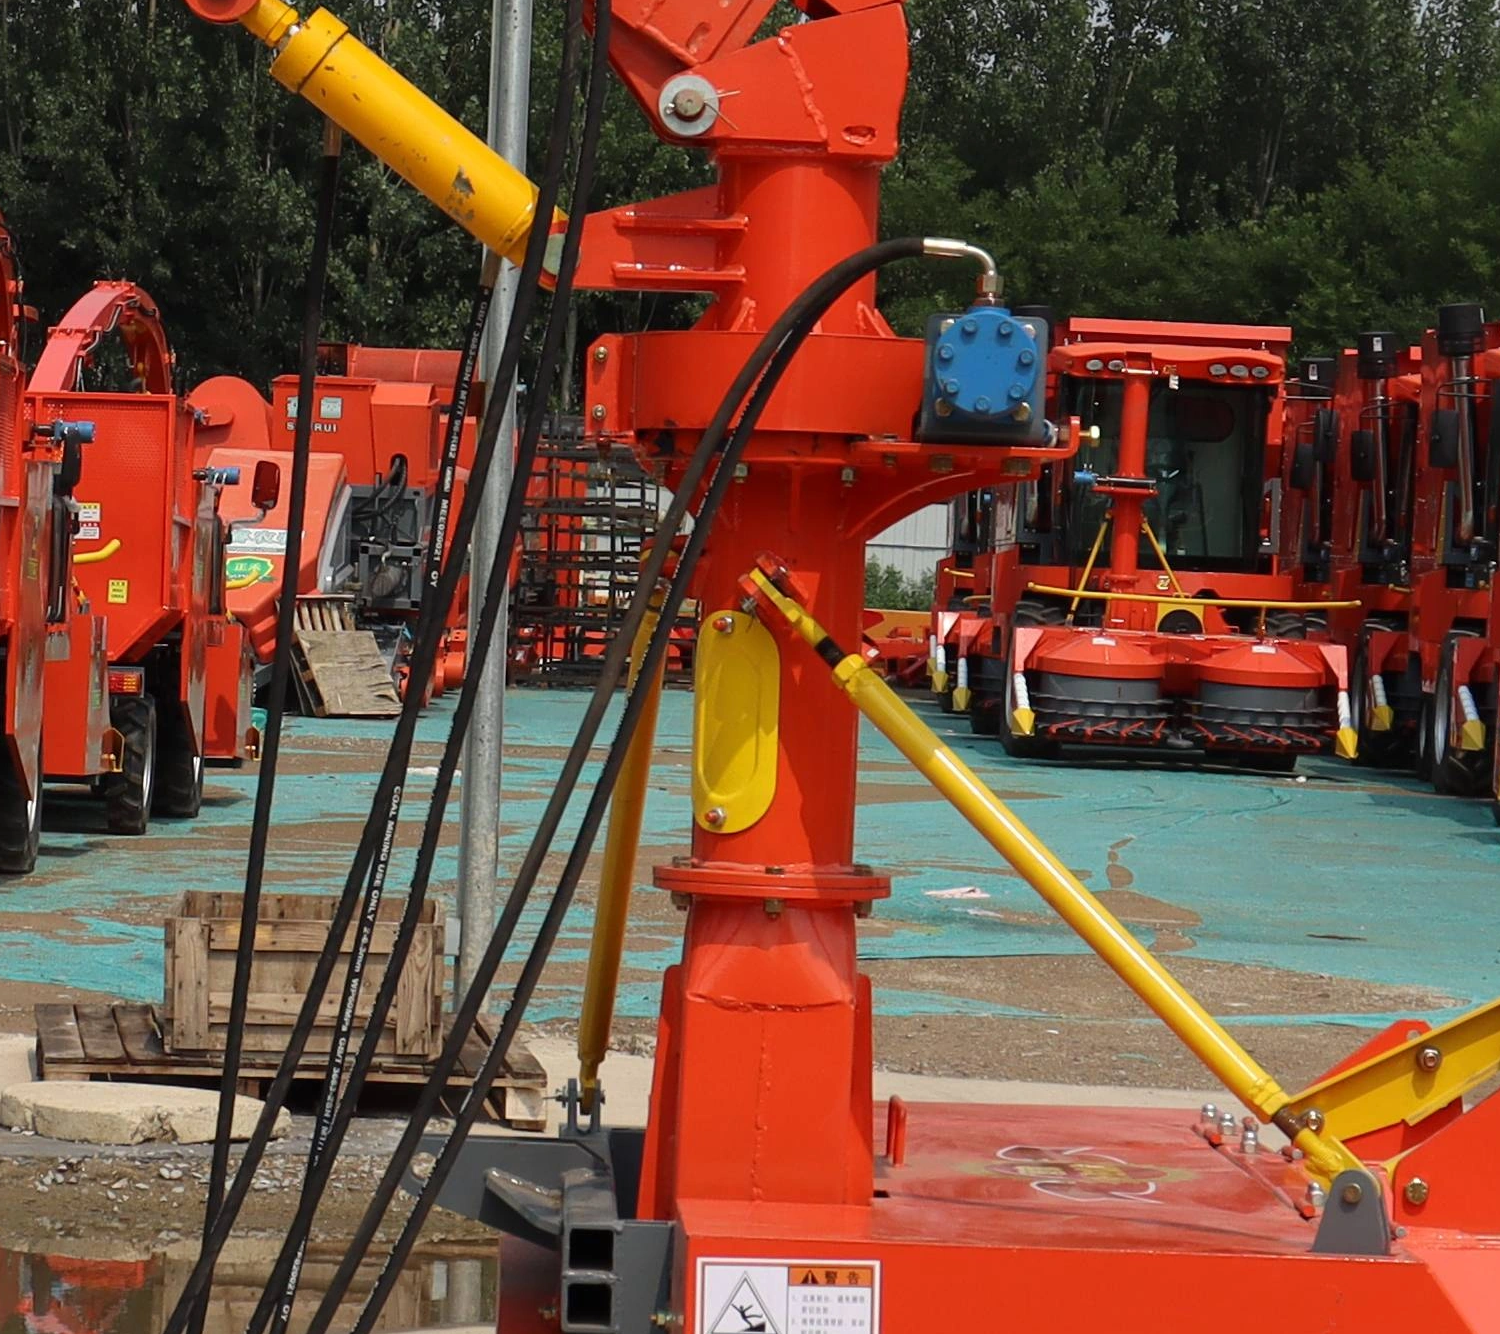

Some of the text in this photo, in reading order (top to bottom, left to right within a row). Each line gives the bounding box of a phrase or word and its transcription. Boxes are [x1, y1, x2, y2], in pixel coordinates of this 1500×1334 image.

[286, 421, 337, 433] SRUI
[388, 785, 401, 819] COAL
[379, 819, 395, 862] MINING
[373, 863, 385, 887] USE
[365, 888, 379, 922] ONLY
